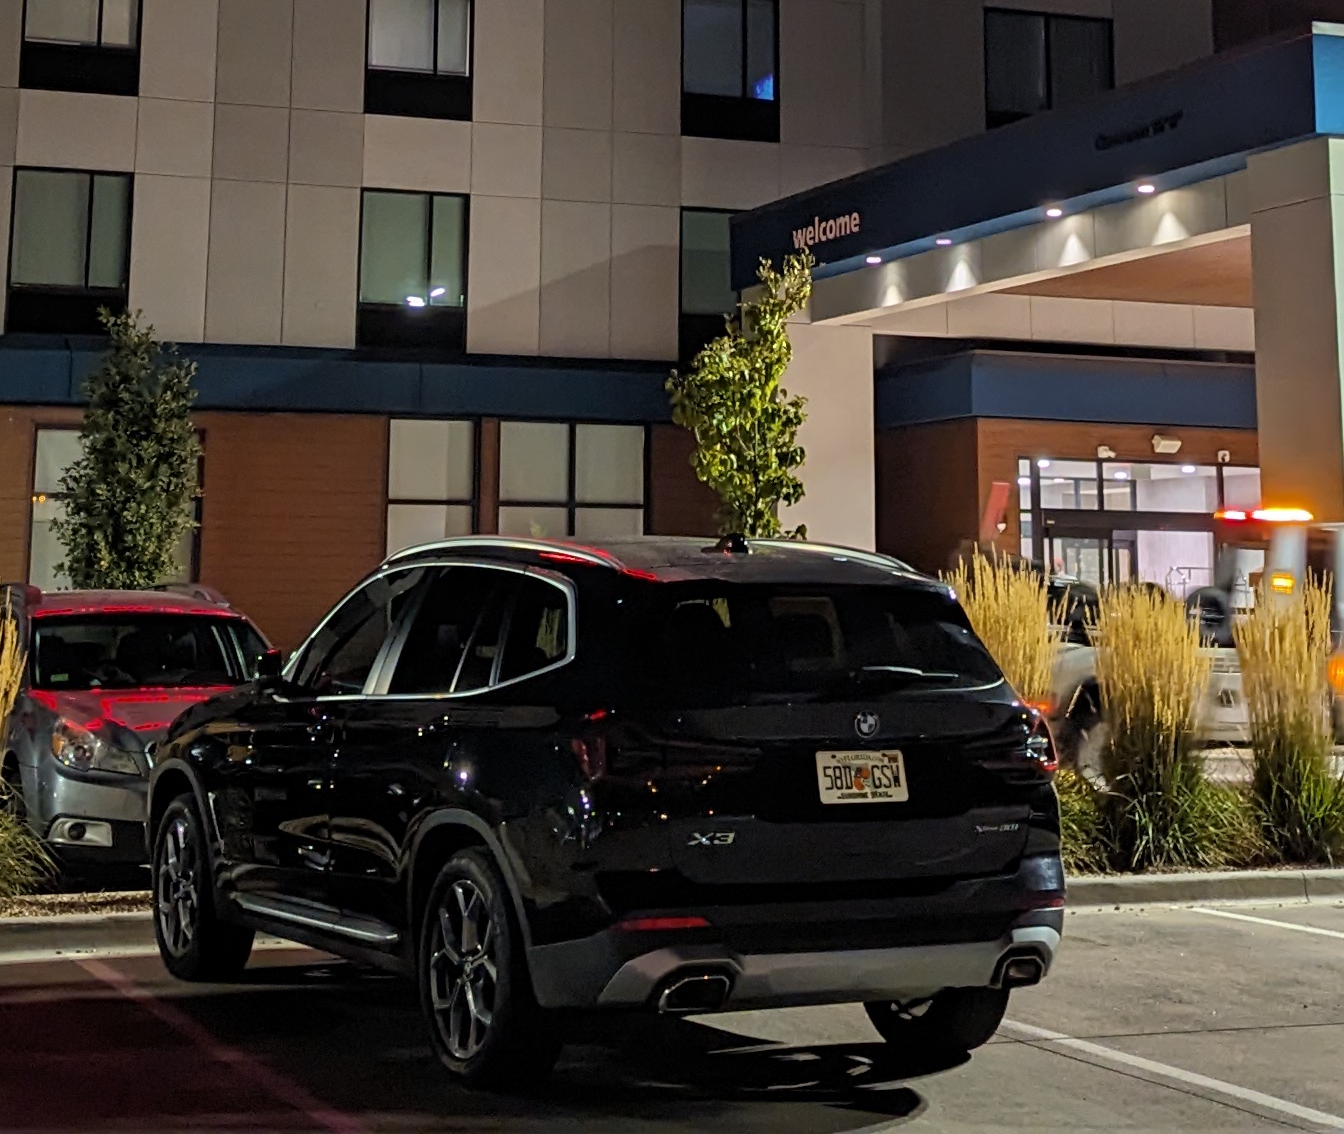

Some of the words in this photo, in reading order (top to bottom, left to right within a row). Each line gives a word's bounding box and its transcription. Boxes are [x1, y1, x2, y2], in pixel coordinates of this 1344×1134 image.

[792, 211, 860, 249] welcome
[822, 766, 854, 791] 58D
[686, 831, 736, 845] X3
